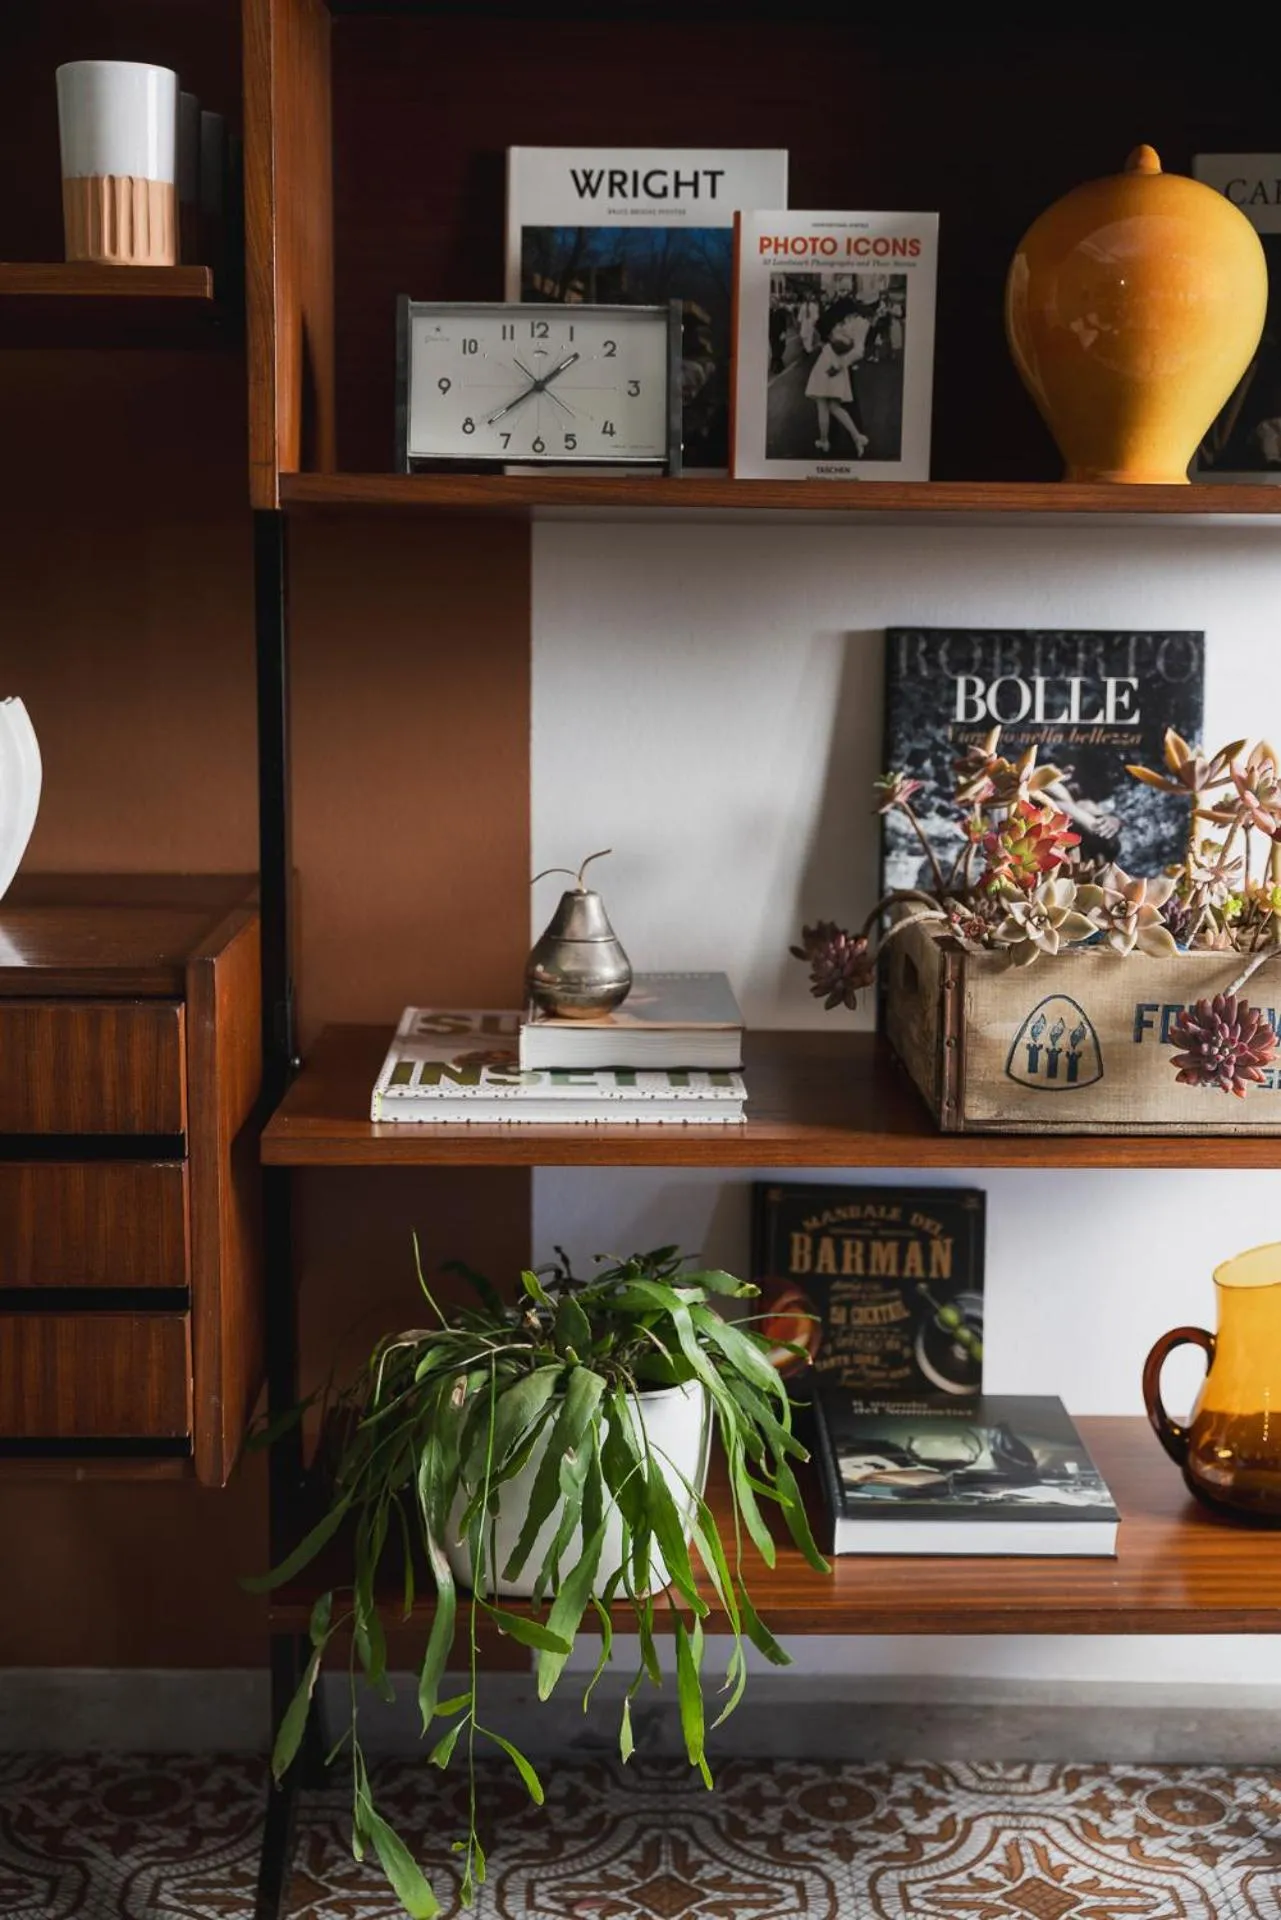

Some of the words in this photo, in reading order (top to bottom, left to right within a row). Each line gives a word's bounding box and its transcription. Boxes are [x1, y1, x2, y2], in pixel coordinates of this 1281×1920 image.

[570, 168, 725, 199] WRIGHT
[759, 236, 838, 256] PHOTO
[846, 237, 922, 257] ICONS
[502, 324, 514, 341] 11
[531, 321, 549, 338] 12
[568, 325, 575, 342] 1
[462, 338, 478, 355] 10
[603, 340, 617, 357] 2
[438, 377, 451, 395] 9
[628, 380, 640, 397] 3
[462, 416, 475, 434] 8
[602, 420, 616, 437] 4
[500, 433, 511, 449] 7
[532, 435, 545, 453] 6
[564, 433, 577, 450] 5
[897, 634, 1201, 684] ROBERTO
[951, 675, 1140, 724] BOLLE
[1020, 725, 1064, 745] nella
[1068, 725, 1142, 745] bellezza
[909, 1212, 944, 1237] DEL
[789, 1232, 955, 1279] BARMAN
